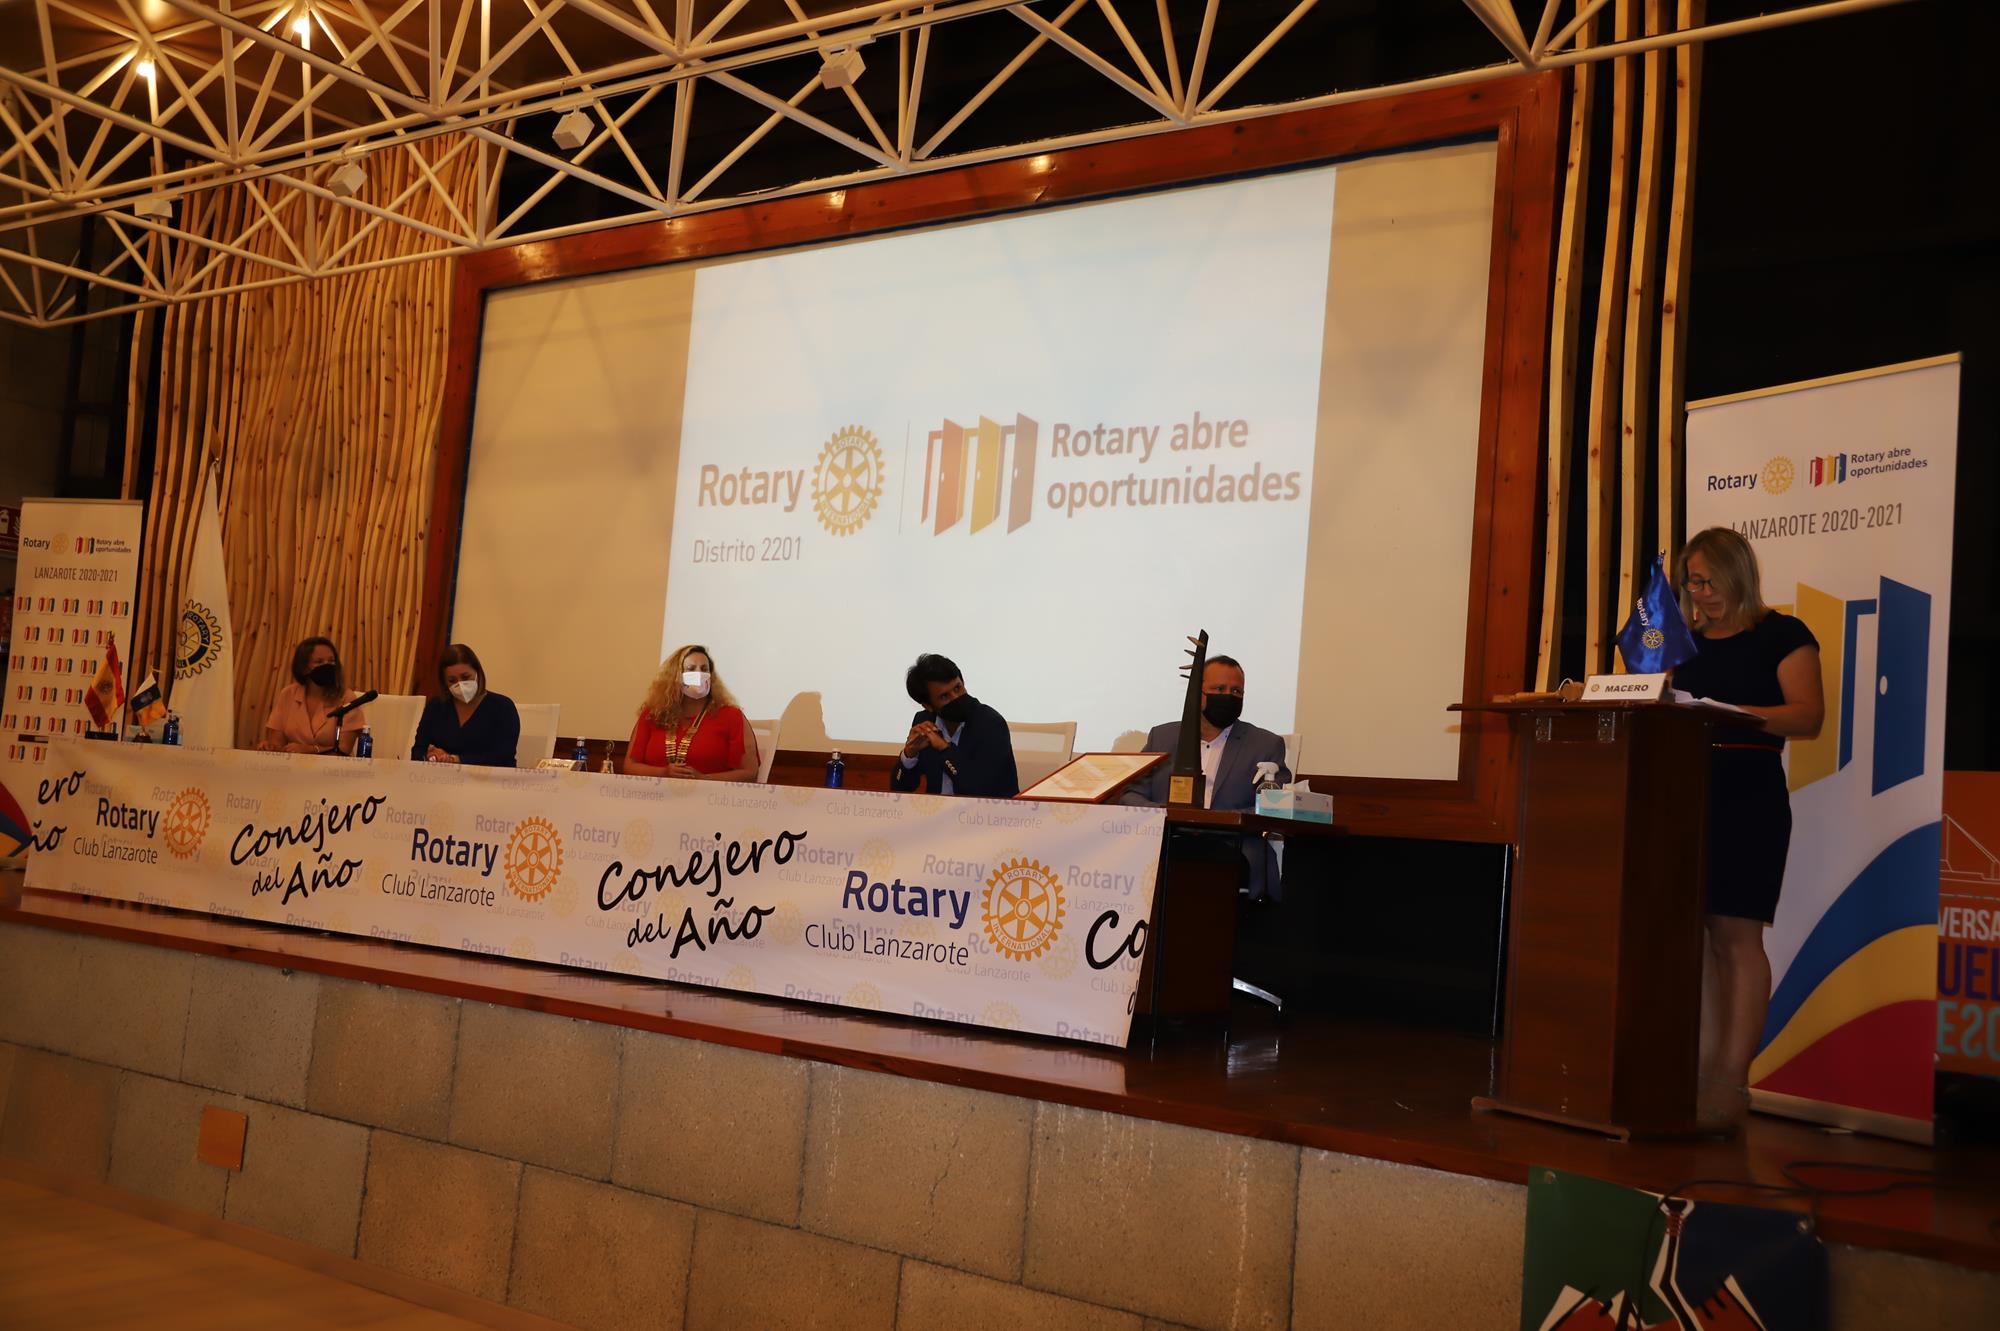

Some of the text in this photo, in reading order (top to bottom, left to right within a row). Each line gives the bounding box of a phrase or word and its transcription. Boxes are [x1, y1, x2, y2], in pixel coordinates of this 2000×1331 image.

[835, 435, 865, 450] ROTARY
[1051, 410, 1249, 464] Rotary abre
[1850, 457, 1928, 478] oportunidades
[1851, 446, 1911, 465] Rotary abre
[698, 464, 805, 513] Rotary
[1047, 460, 1301, 519] oportunidades
[1707, 473, 1758, 491] Rotary
[1732, 502, 1903, 542] LANZAROTE 2020-2021
[23, 537, 51, 550] Rotary
[692, 536, 802, 564] Distrito 2201
[34, 566, 119, 582] LANZAROTE 2020-2021
[187, 611, 210, 643] ROTARY
[1604, 684, 1650, 693] MACERO
[38, 770, 86, 805] ero
[600, 784, 664, 801] Club Lanzarote
[707, 793, 778, 810] Club Lanzarote
[226, 793, 262, 813] Rotary
[826, 802, 903, 820] Club Lanzarote
[96, 797, 160, 839] Rotary
[230, 794, 387, 866] Conejero
[958, 811, 1042, 829] Club Lanzarote
[1101, 820, 1132, 834] Club
[572, 823, 621, 848] Rotary
[73, 836, 99, 859] Club
[101, 838, 159, 865] Lanzarote
[411, 828, 499, 877] Rotary
[796, 843, 855, 870] Rotary
[252, 867, 285, 896] del
[281, 852, 363, 906] Año
[597, 830, 807, 911] Conejero
[778, 868, 801, 882] Club
[922, 854, 986, 882] Rotary
[1006, 869, 1045, 881] ROTARY
[1067, 864, 1135, 896] Rotary
[381, 873, 416, 897] Club
[420, 877, 496, 907] Lanzarote
[842, 870, 970, 930] Rotary
[627, 912, 671, 948] del
[669, 896, 776, 959] Año
[992, 922, 1052, 951] INTERNATIONAL
[804, 924, 855, 952] Club
[863, 930, 969, 967] Lanzarote
[1090, 976, 1119, 994] Club
